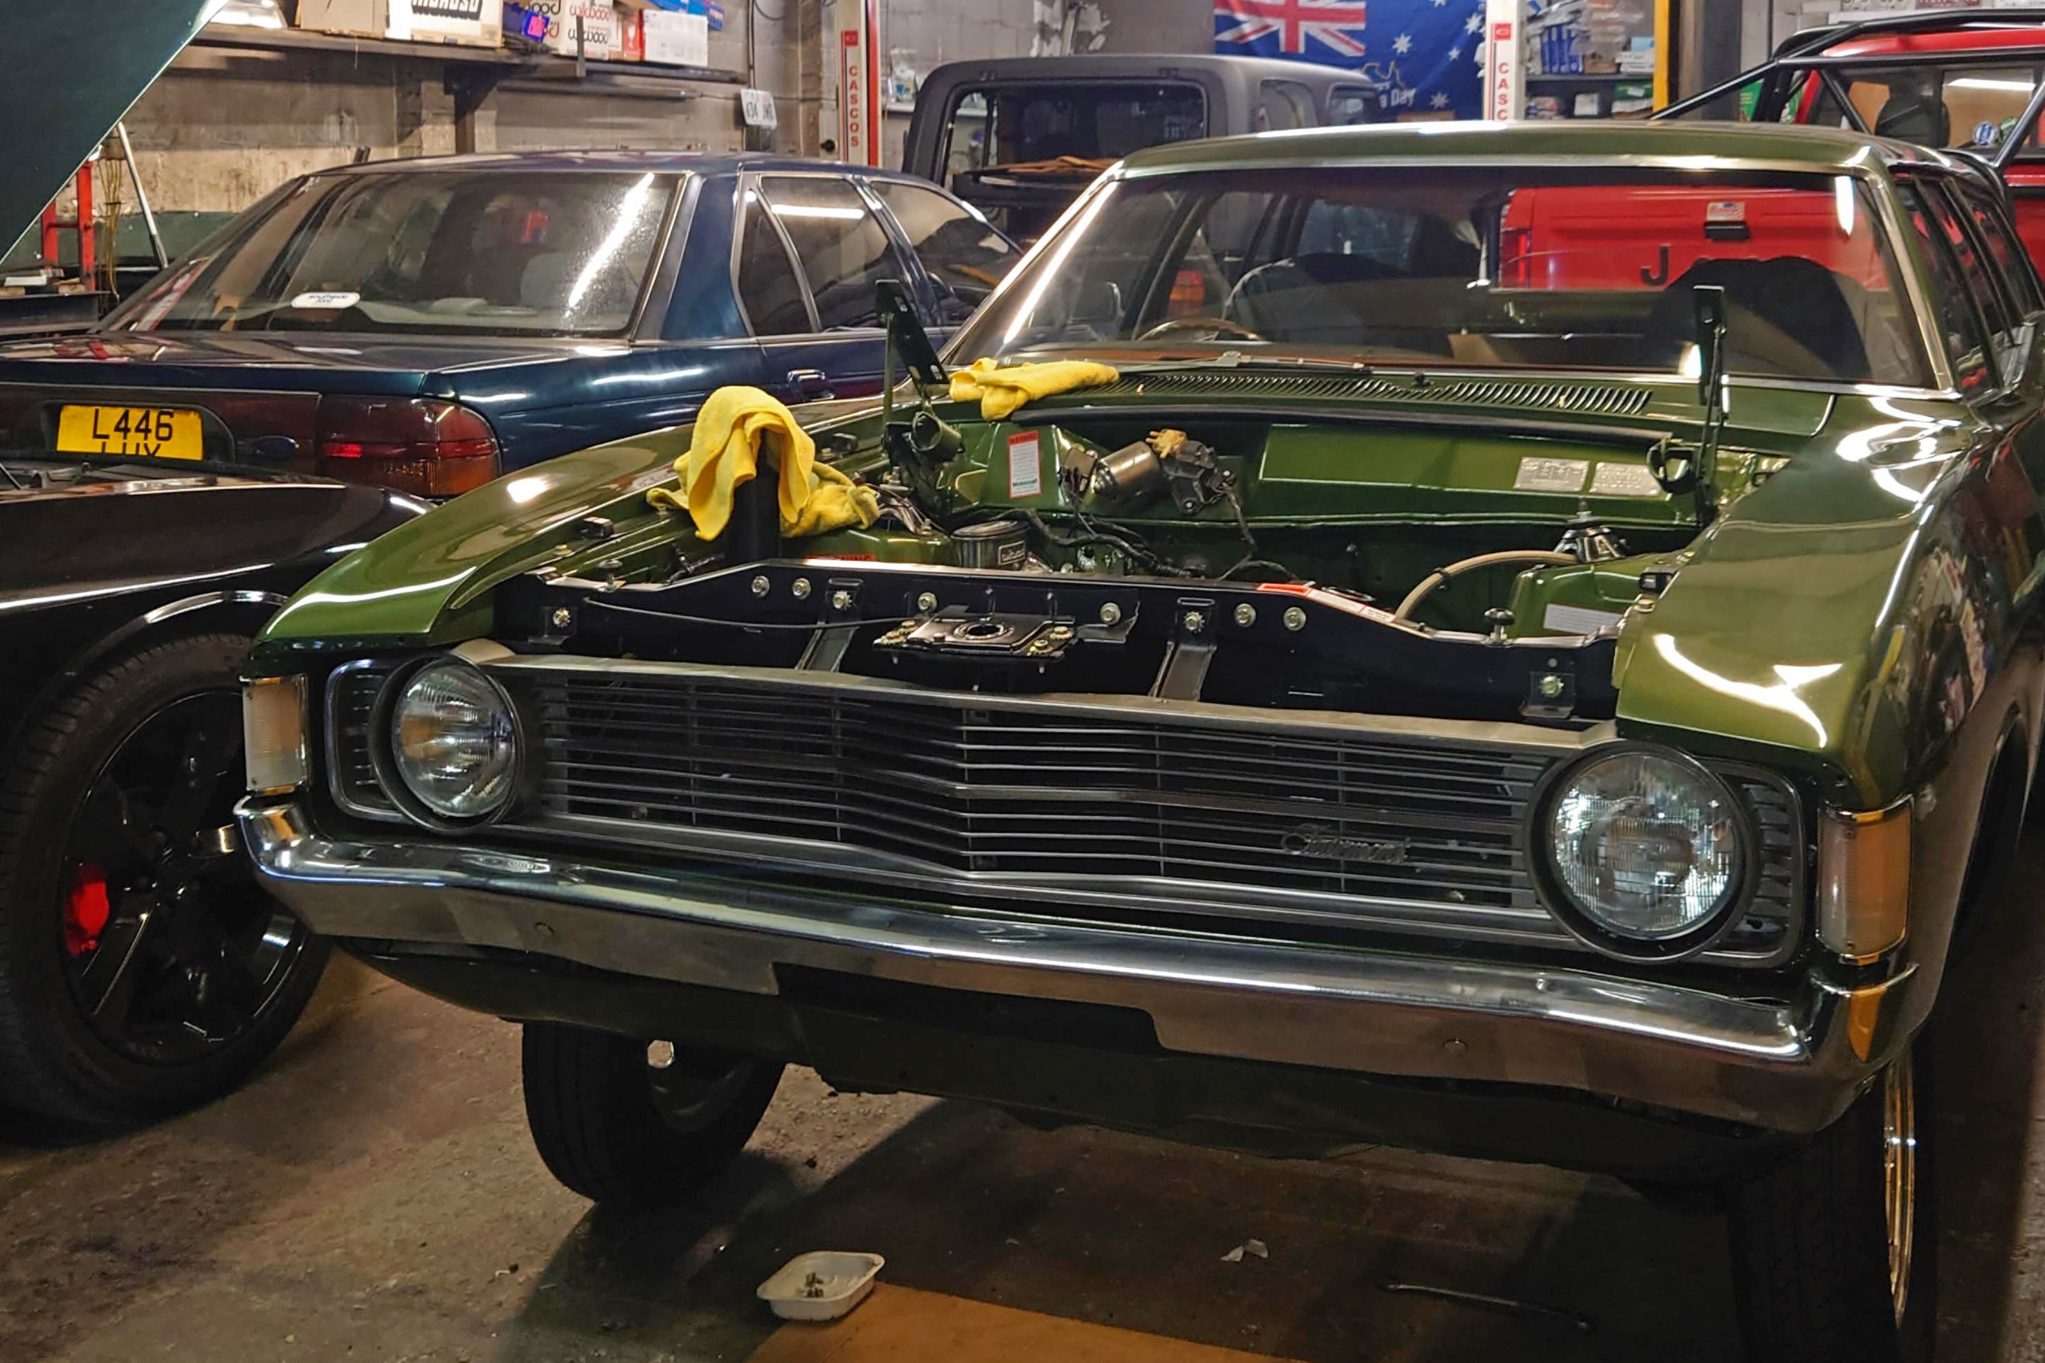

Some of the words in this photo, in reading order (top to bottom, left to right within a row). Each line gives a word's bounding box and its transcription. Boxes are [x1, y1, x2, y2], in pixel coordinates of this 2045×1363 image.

[849, 65, 859, 147] CASCOS
[1391, 87, 1416, 108] Day
[92, 408, 175, 442] L446
